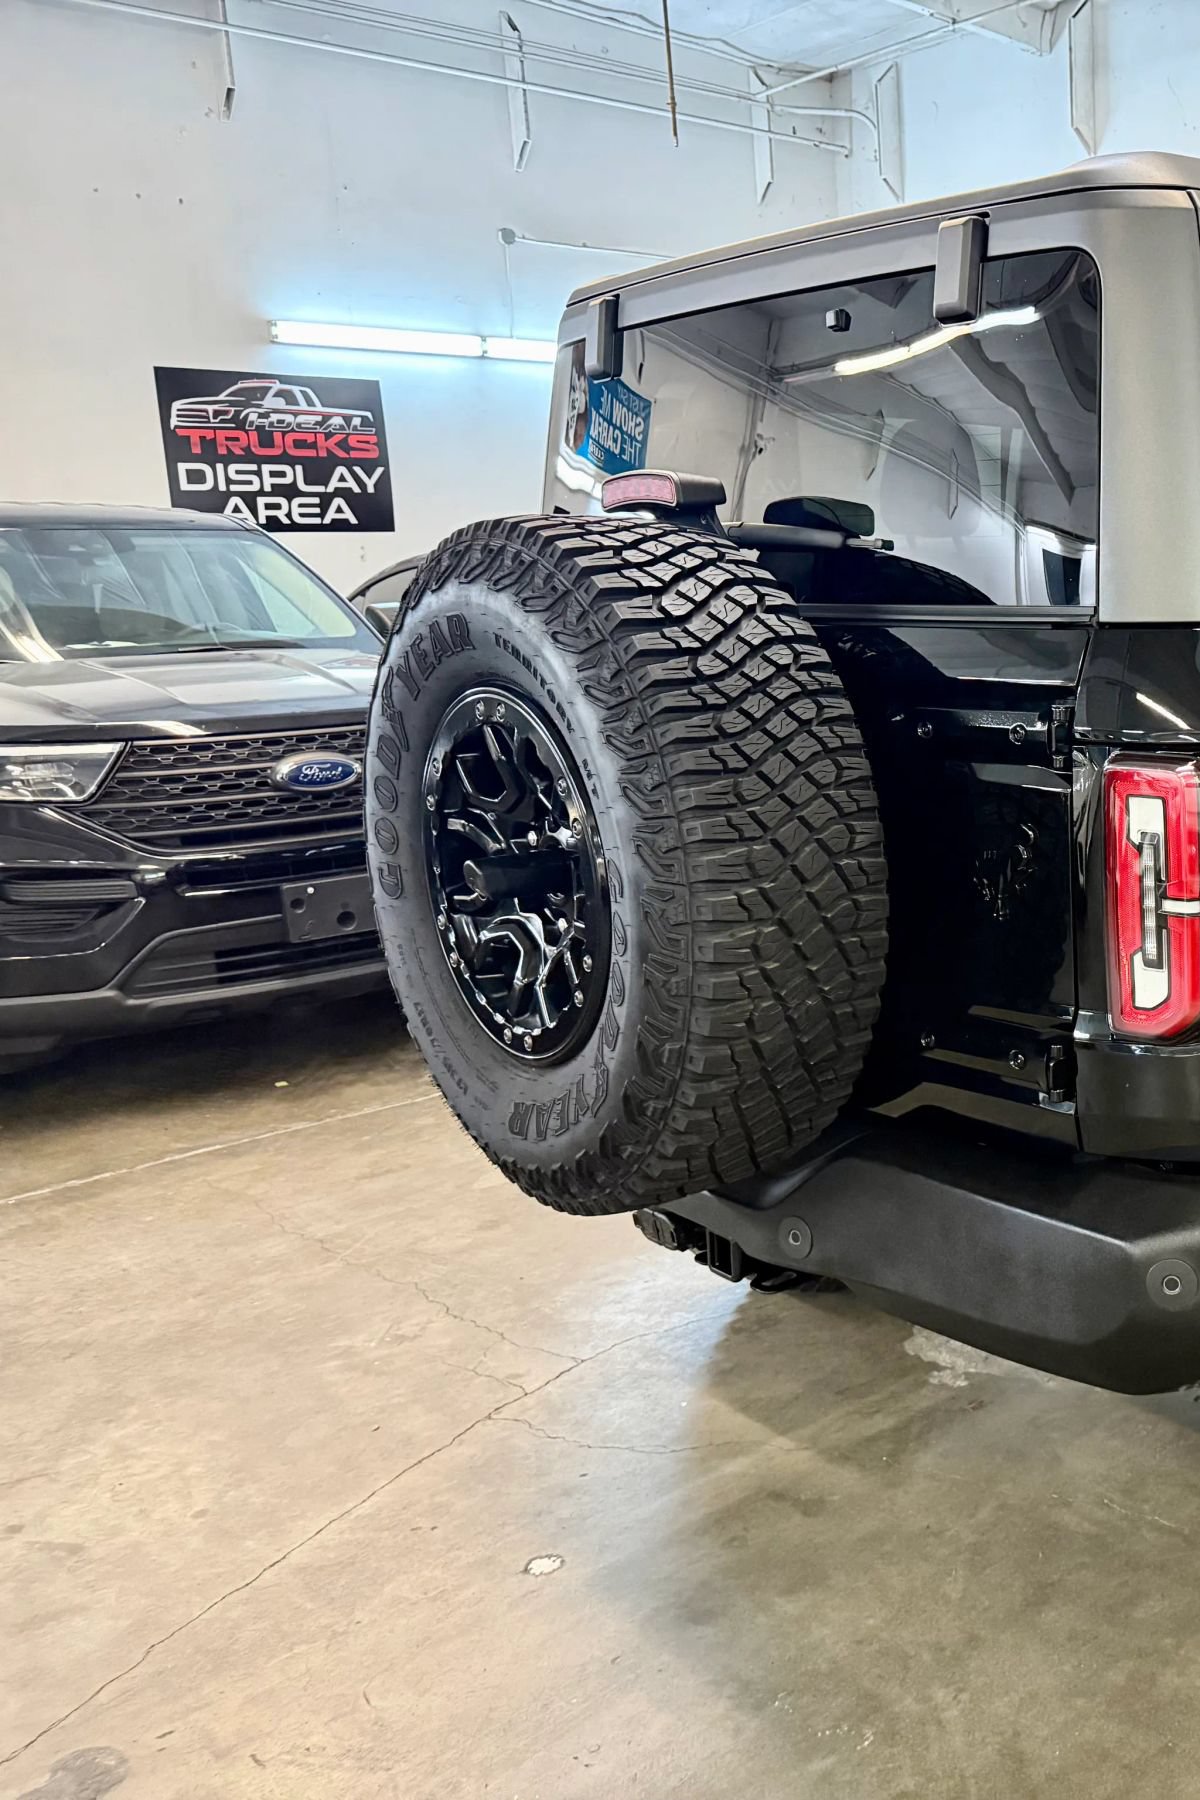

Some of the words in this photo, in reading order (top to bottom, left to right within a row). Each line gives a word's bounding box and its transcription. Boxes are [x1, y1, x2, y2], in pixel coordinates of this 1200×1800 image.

[245, 412, 377, 434] I-DEAL
[175, 428, 380, 458] TRUCKS
[177, 462, 385, 494] DISPLAY
[223, 496, 359, 525] AREA
[299, 763, 343, 782] Ford
